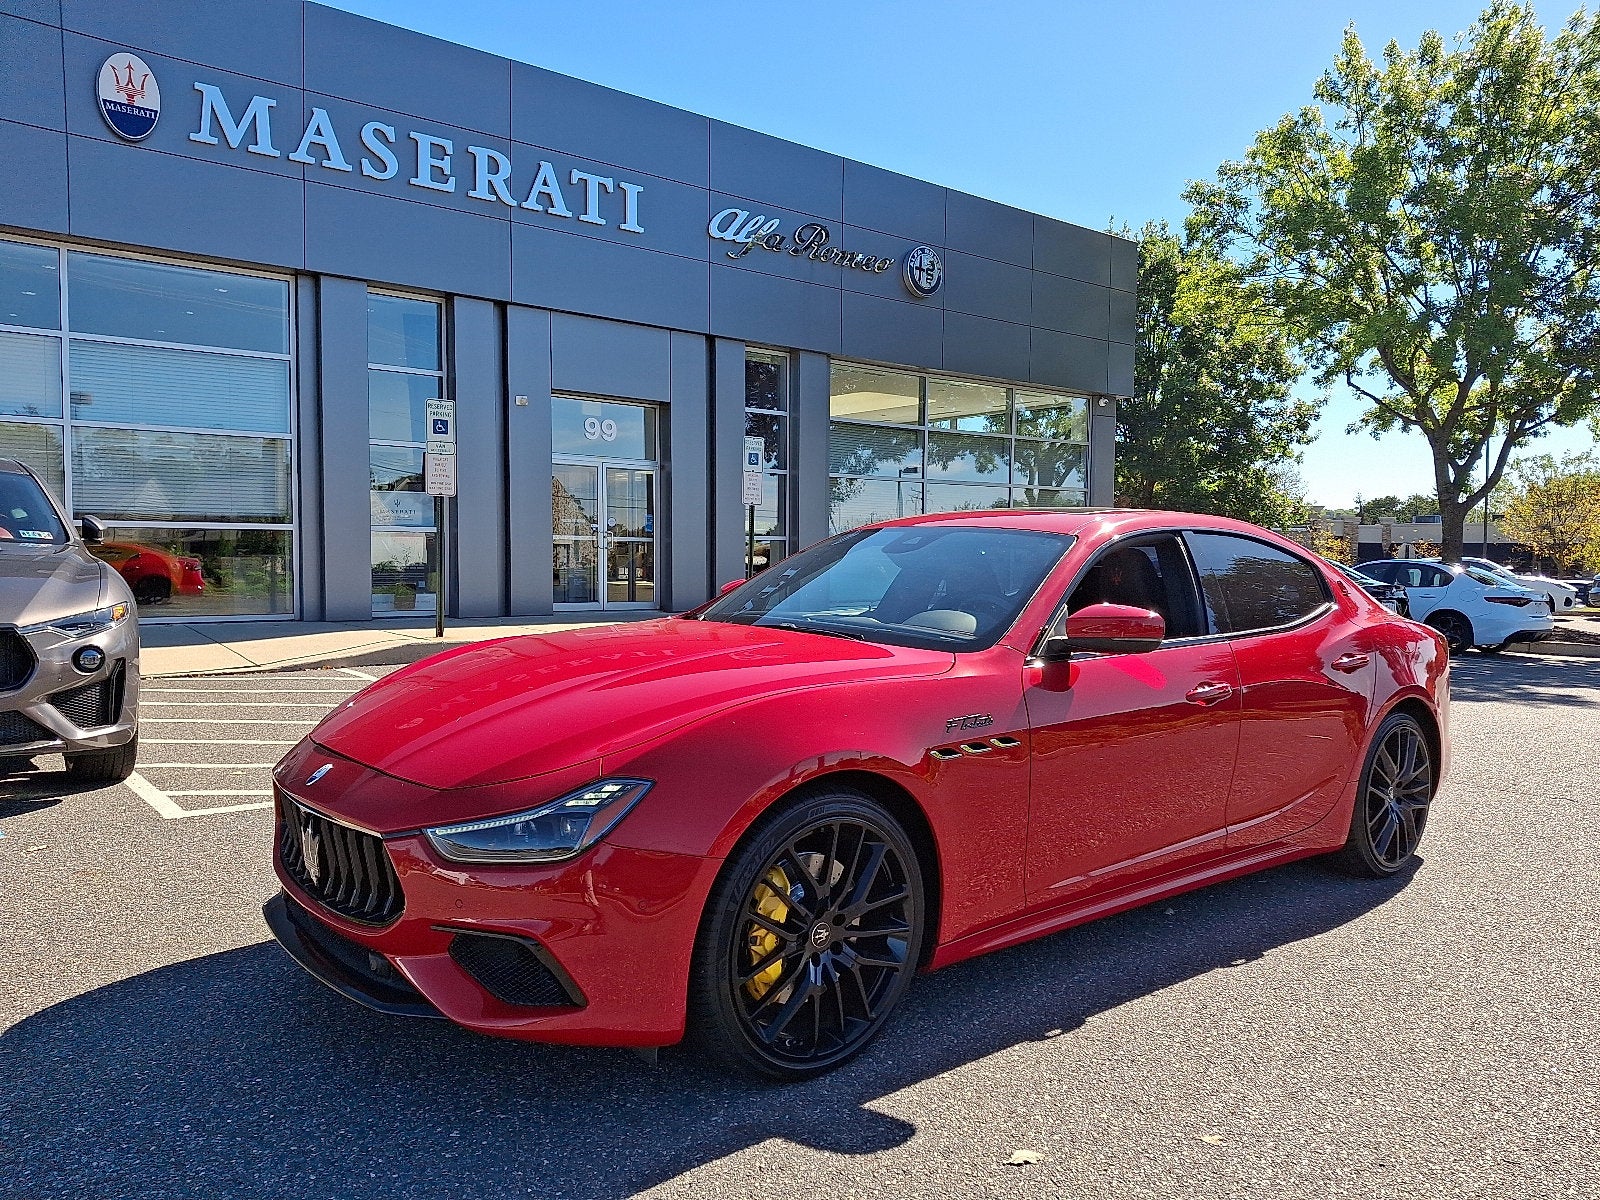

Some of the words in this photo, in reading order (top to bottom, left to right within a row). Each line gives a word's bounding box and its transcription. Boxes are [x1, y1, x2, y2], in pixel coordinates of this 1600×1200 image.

[105, 102, 156, 120] MASERATI
[188, 80, 646, 234] MASERATI
[788, 222, 895, 273] Romeo
[428, 403, 453, 411] RESERVED
[584, 417, 617, 441] 99
